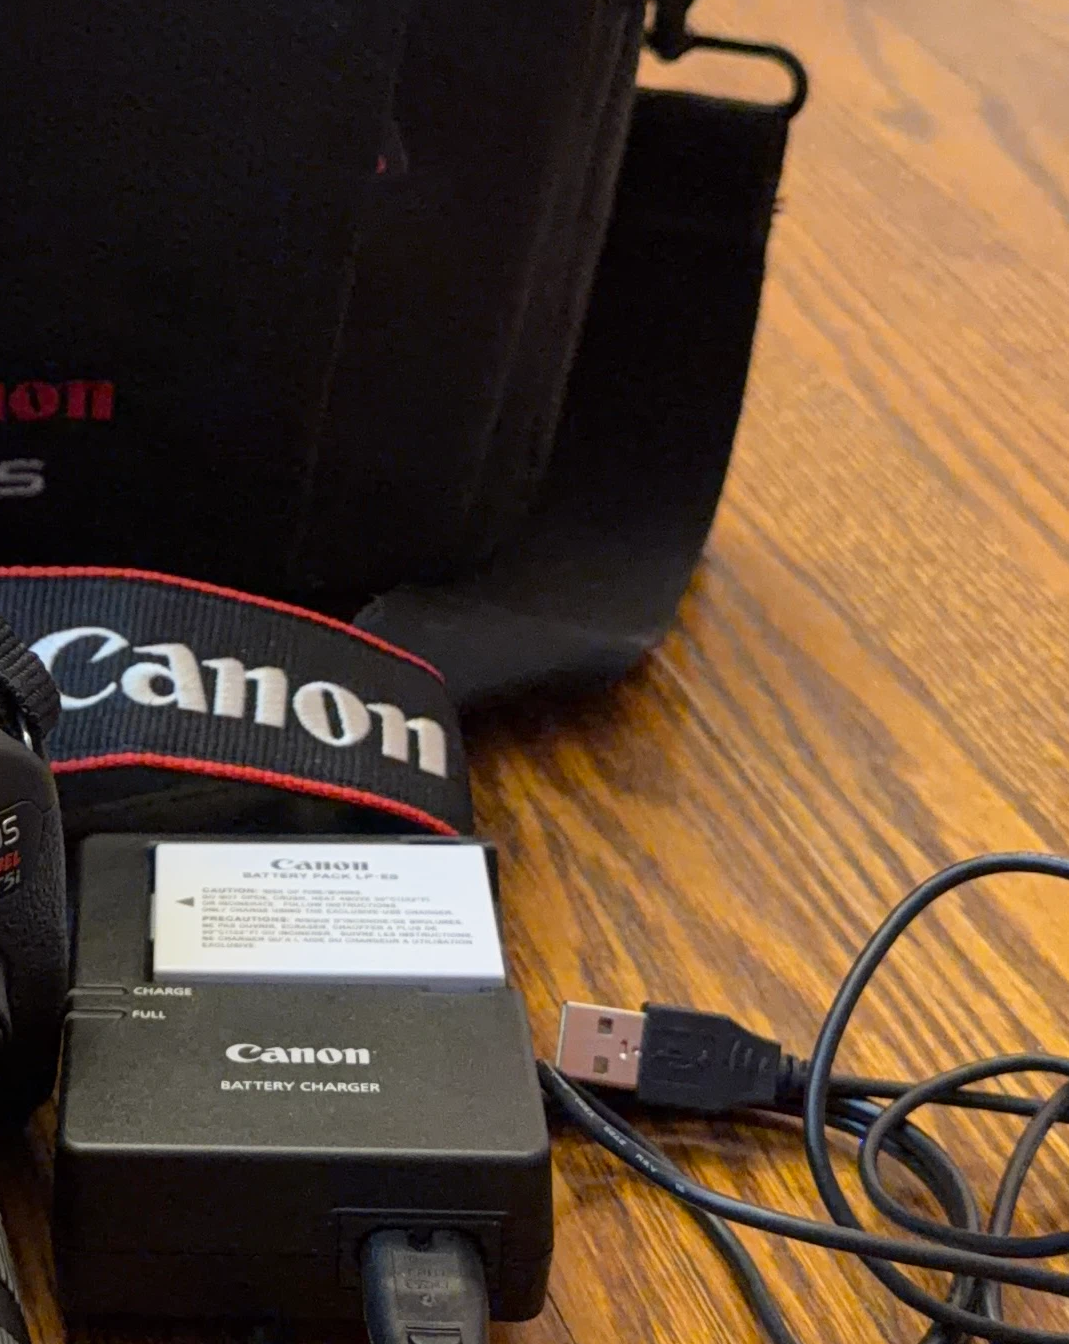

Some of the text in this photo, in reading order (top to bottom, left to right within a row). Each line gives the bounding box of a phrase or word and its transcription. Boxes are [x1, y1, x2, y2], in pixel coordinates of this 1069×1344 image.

[29, 626, 447, 778] Canon
[270, 858, 370, 872] Canon
[242, 871, 308, 879] BATTERY
[312, 872, 352, 880] PACK
[132, 986, 193, 997] CHARGE
[131, 1009, 167, 1020] FULL
[225, 1043, 371, 1065] Canon
[220, 1080, 381, 1093] BATTERY CHARGER
